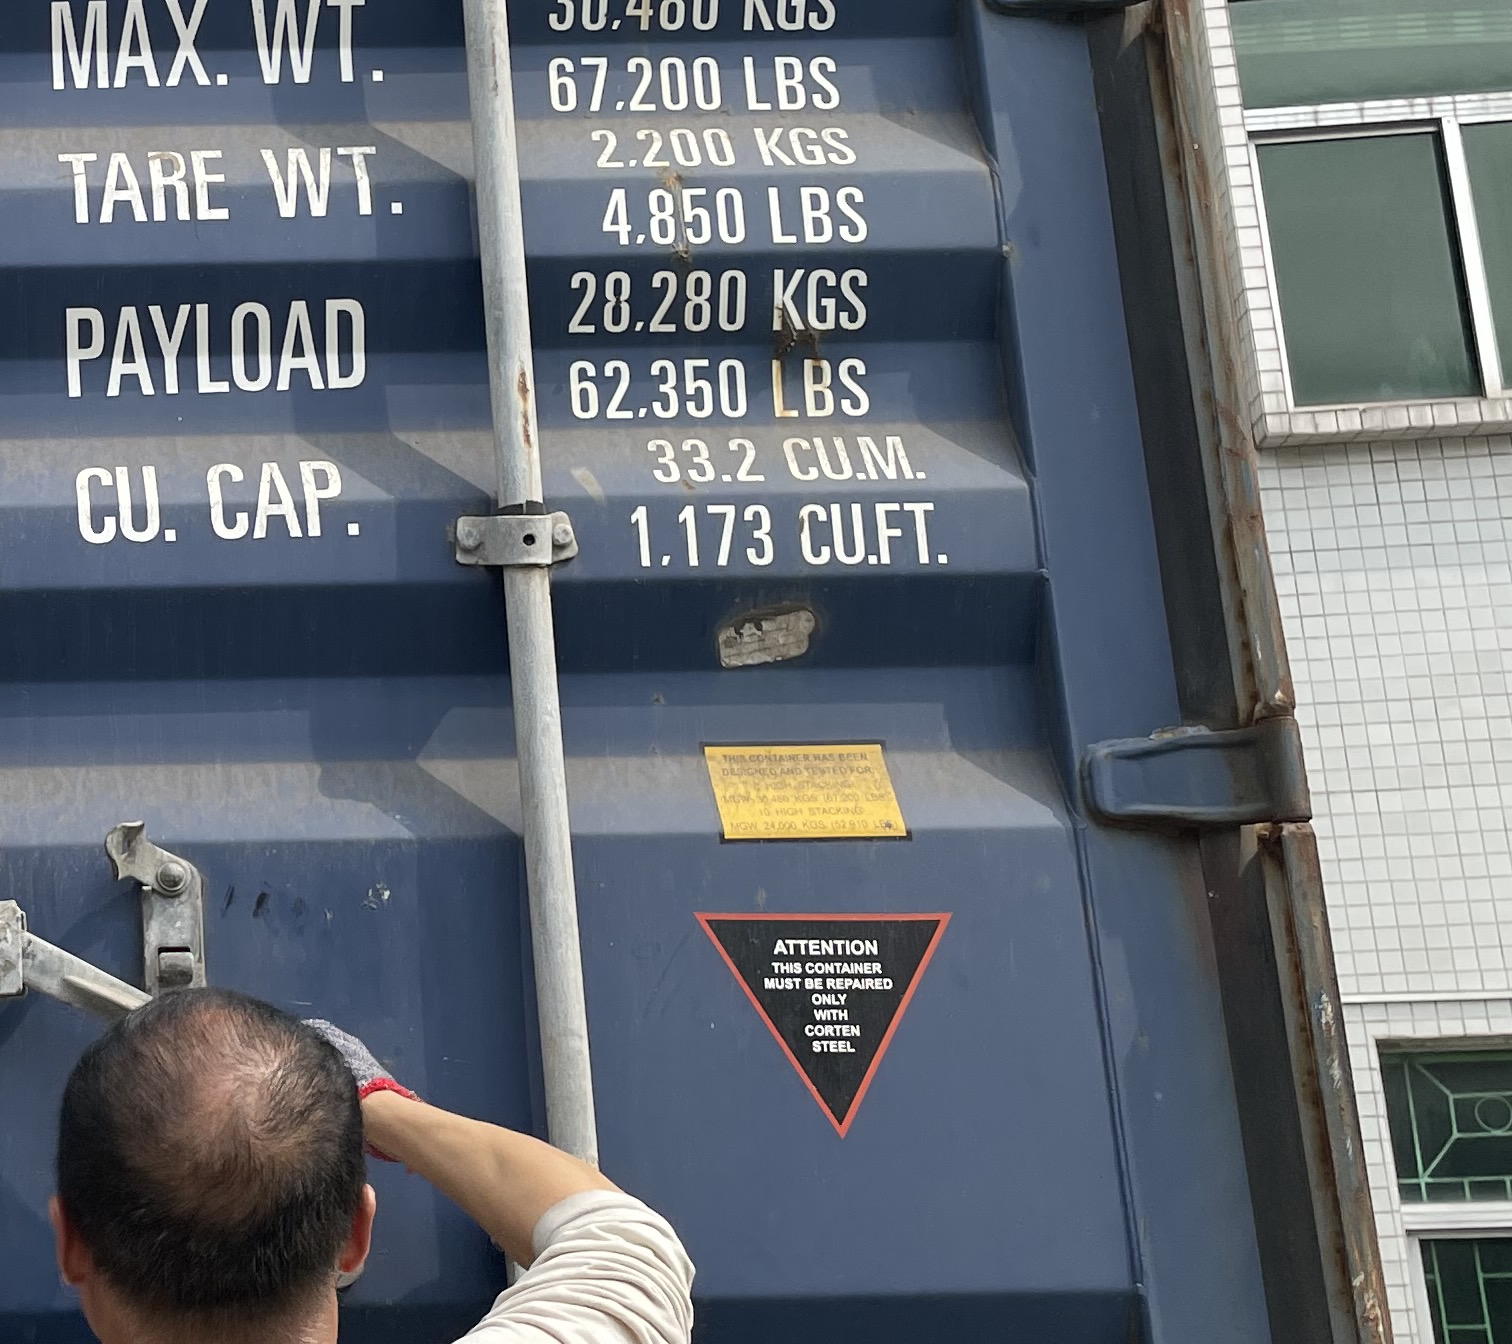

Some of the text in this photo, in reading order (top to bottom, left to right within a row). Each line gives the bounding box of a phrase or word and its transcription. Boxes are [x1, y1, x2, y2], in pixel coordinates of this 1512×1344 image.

[743, 55, 841, 111] LBS
[752, 126, 857, 167] KGS
[57, 145, 404, 224] TARE WT.
[767, 186, 869, 244] LBS
[772, 267, 868, 332] KGS
[65, 297, 366, 398] PAYLOAD
[772, 357, 871, 418] LBS
[647, 435, 927, 483] 33.2 CU.M.
[74, 460, 360, 543] CU. CAP.
[799, 502, 949, 566] CU.FT.
[722, 767, 777, 777] DESIGNED
[779, 767, 803, 776] AND
[805, 766, 847, 775] TESTED
[747, 753, 811, 763] CONTAINER
[813, 752, 836, 762] HAS
[838, 752, 869, 761] BEEN
[776, 807, 803, 816] HIGH
[808, 805, 863, 816] STACKING
[773, 939, 879, 956] ATTENTION
[772, 962, 882, 975] THIS CONTAINER
[764, 977, 894, 990] MUST BE REPAIRED
[811, 993, 848, 1006] ONLY
[813, 1009, 849, 1021] WITH
[804, 1024, 861, 1037] CORTEN
[812, 1040, 856, 1053] STEEL
